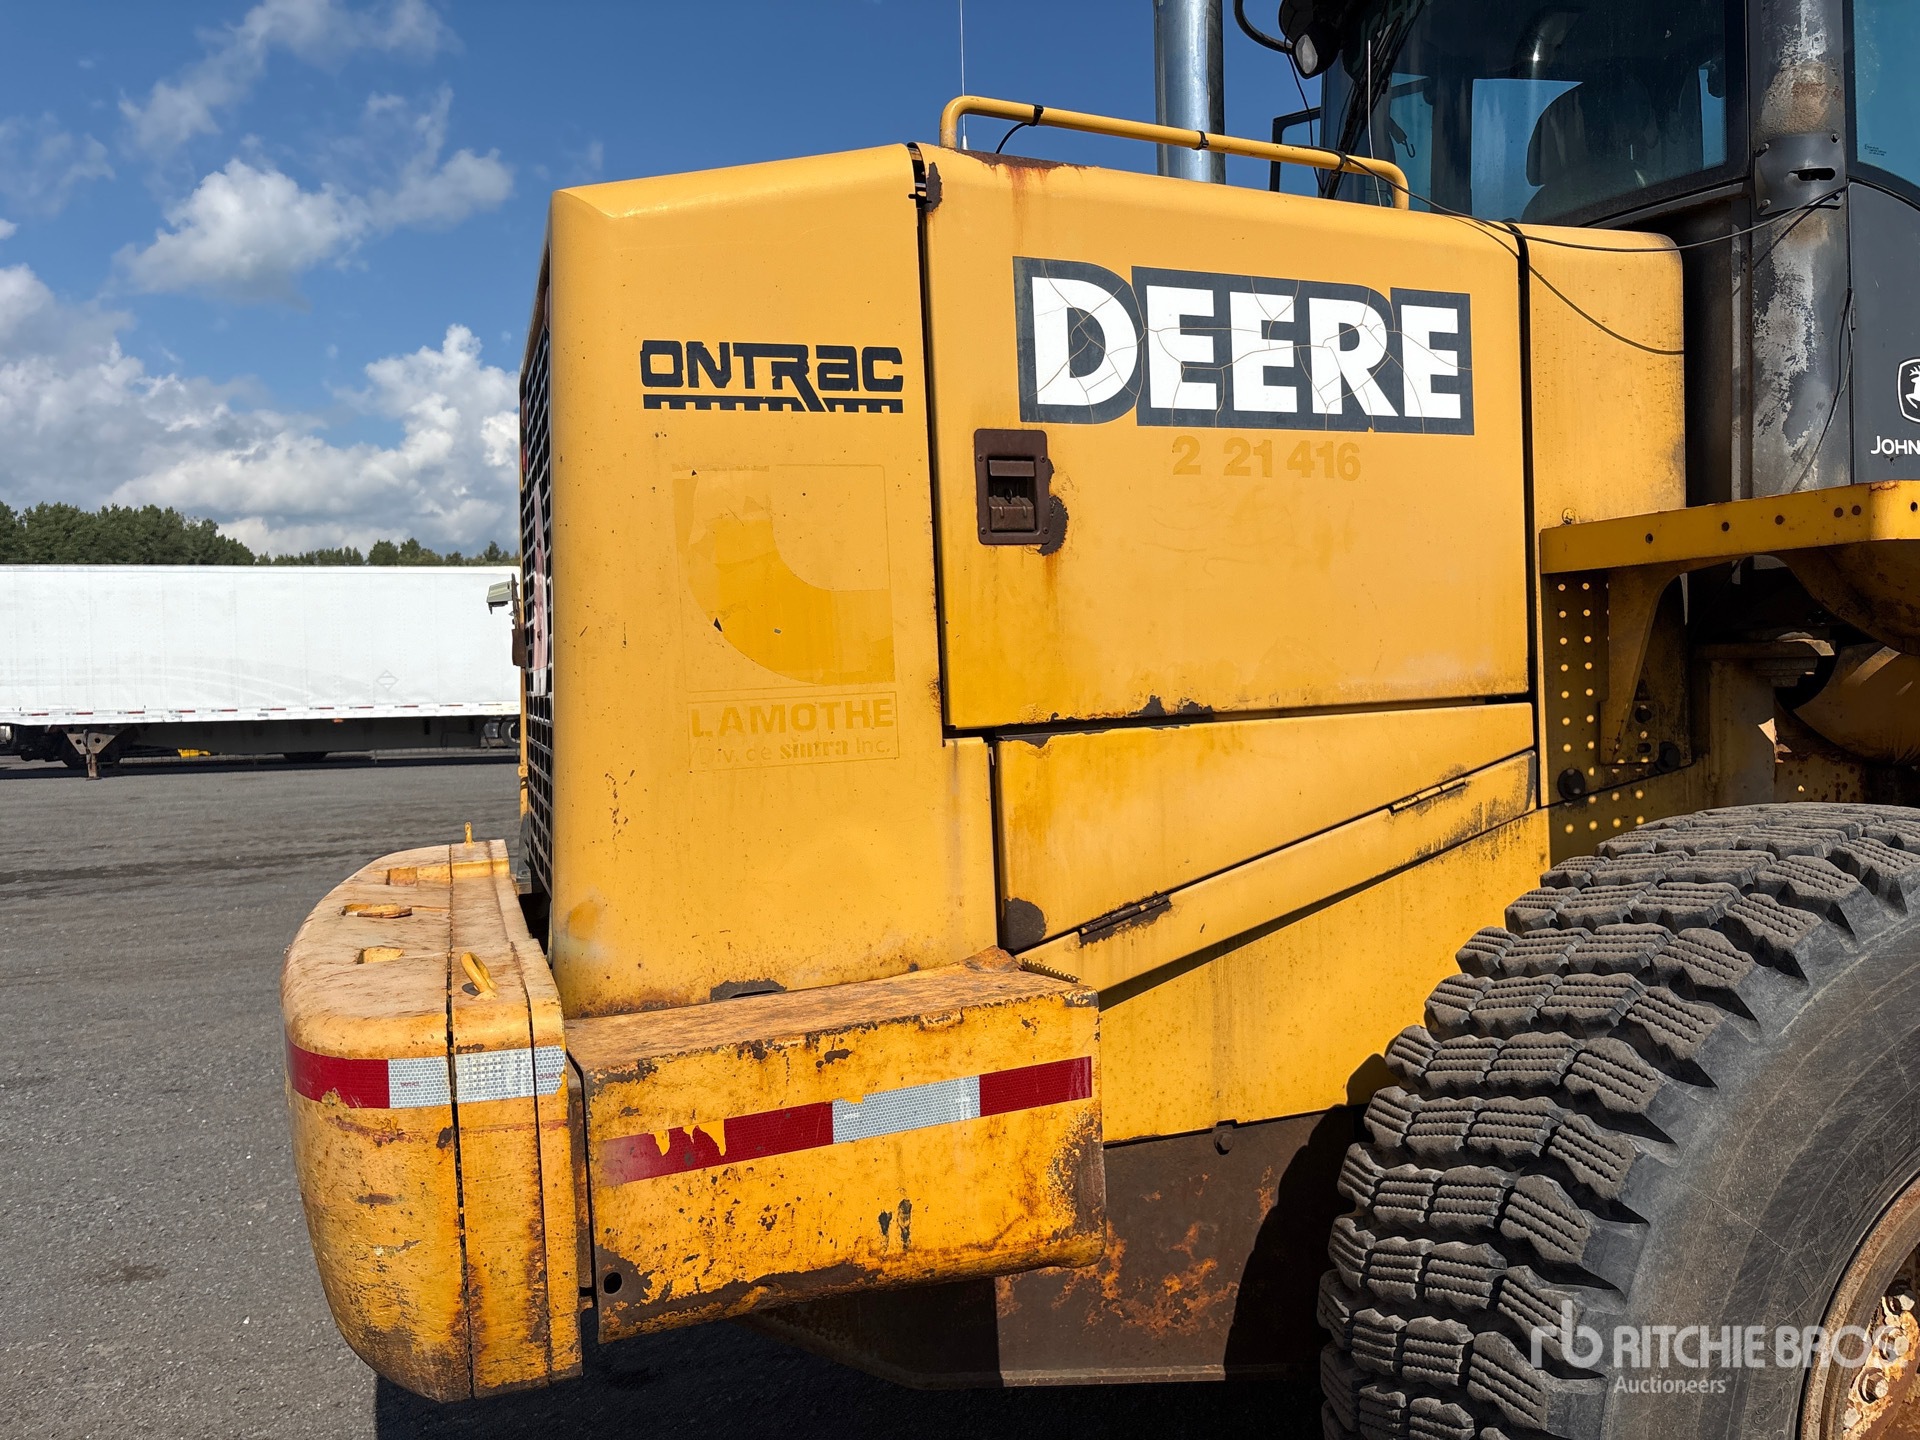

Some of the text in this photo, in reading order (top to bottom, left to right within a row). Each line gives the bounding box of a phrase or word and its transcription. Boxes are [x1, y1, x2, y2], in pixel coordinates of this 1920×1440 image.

[1031, 276, 1463, 419] DEERE
[1171, 435, 1362, 481] 2 21 416
[1870, 435, 1920, 455] JOHN
[691, 698, 894, 738] LAMOTHE
